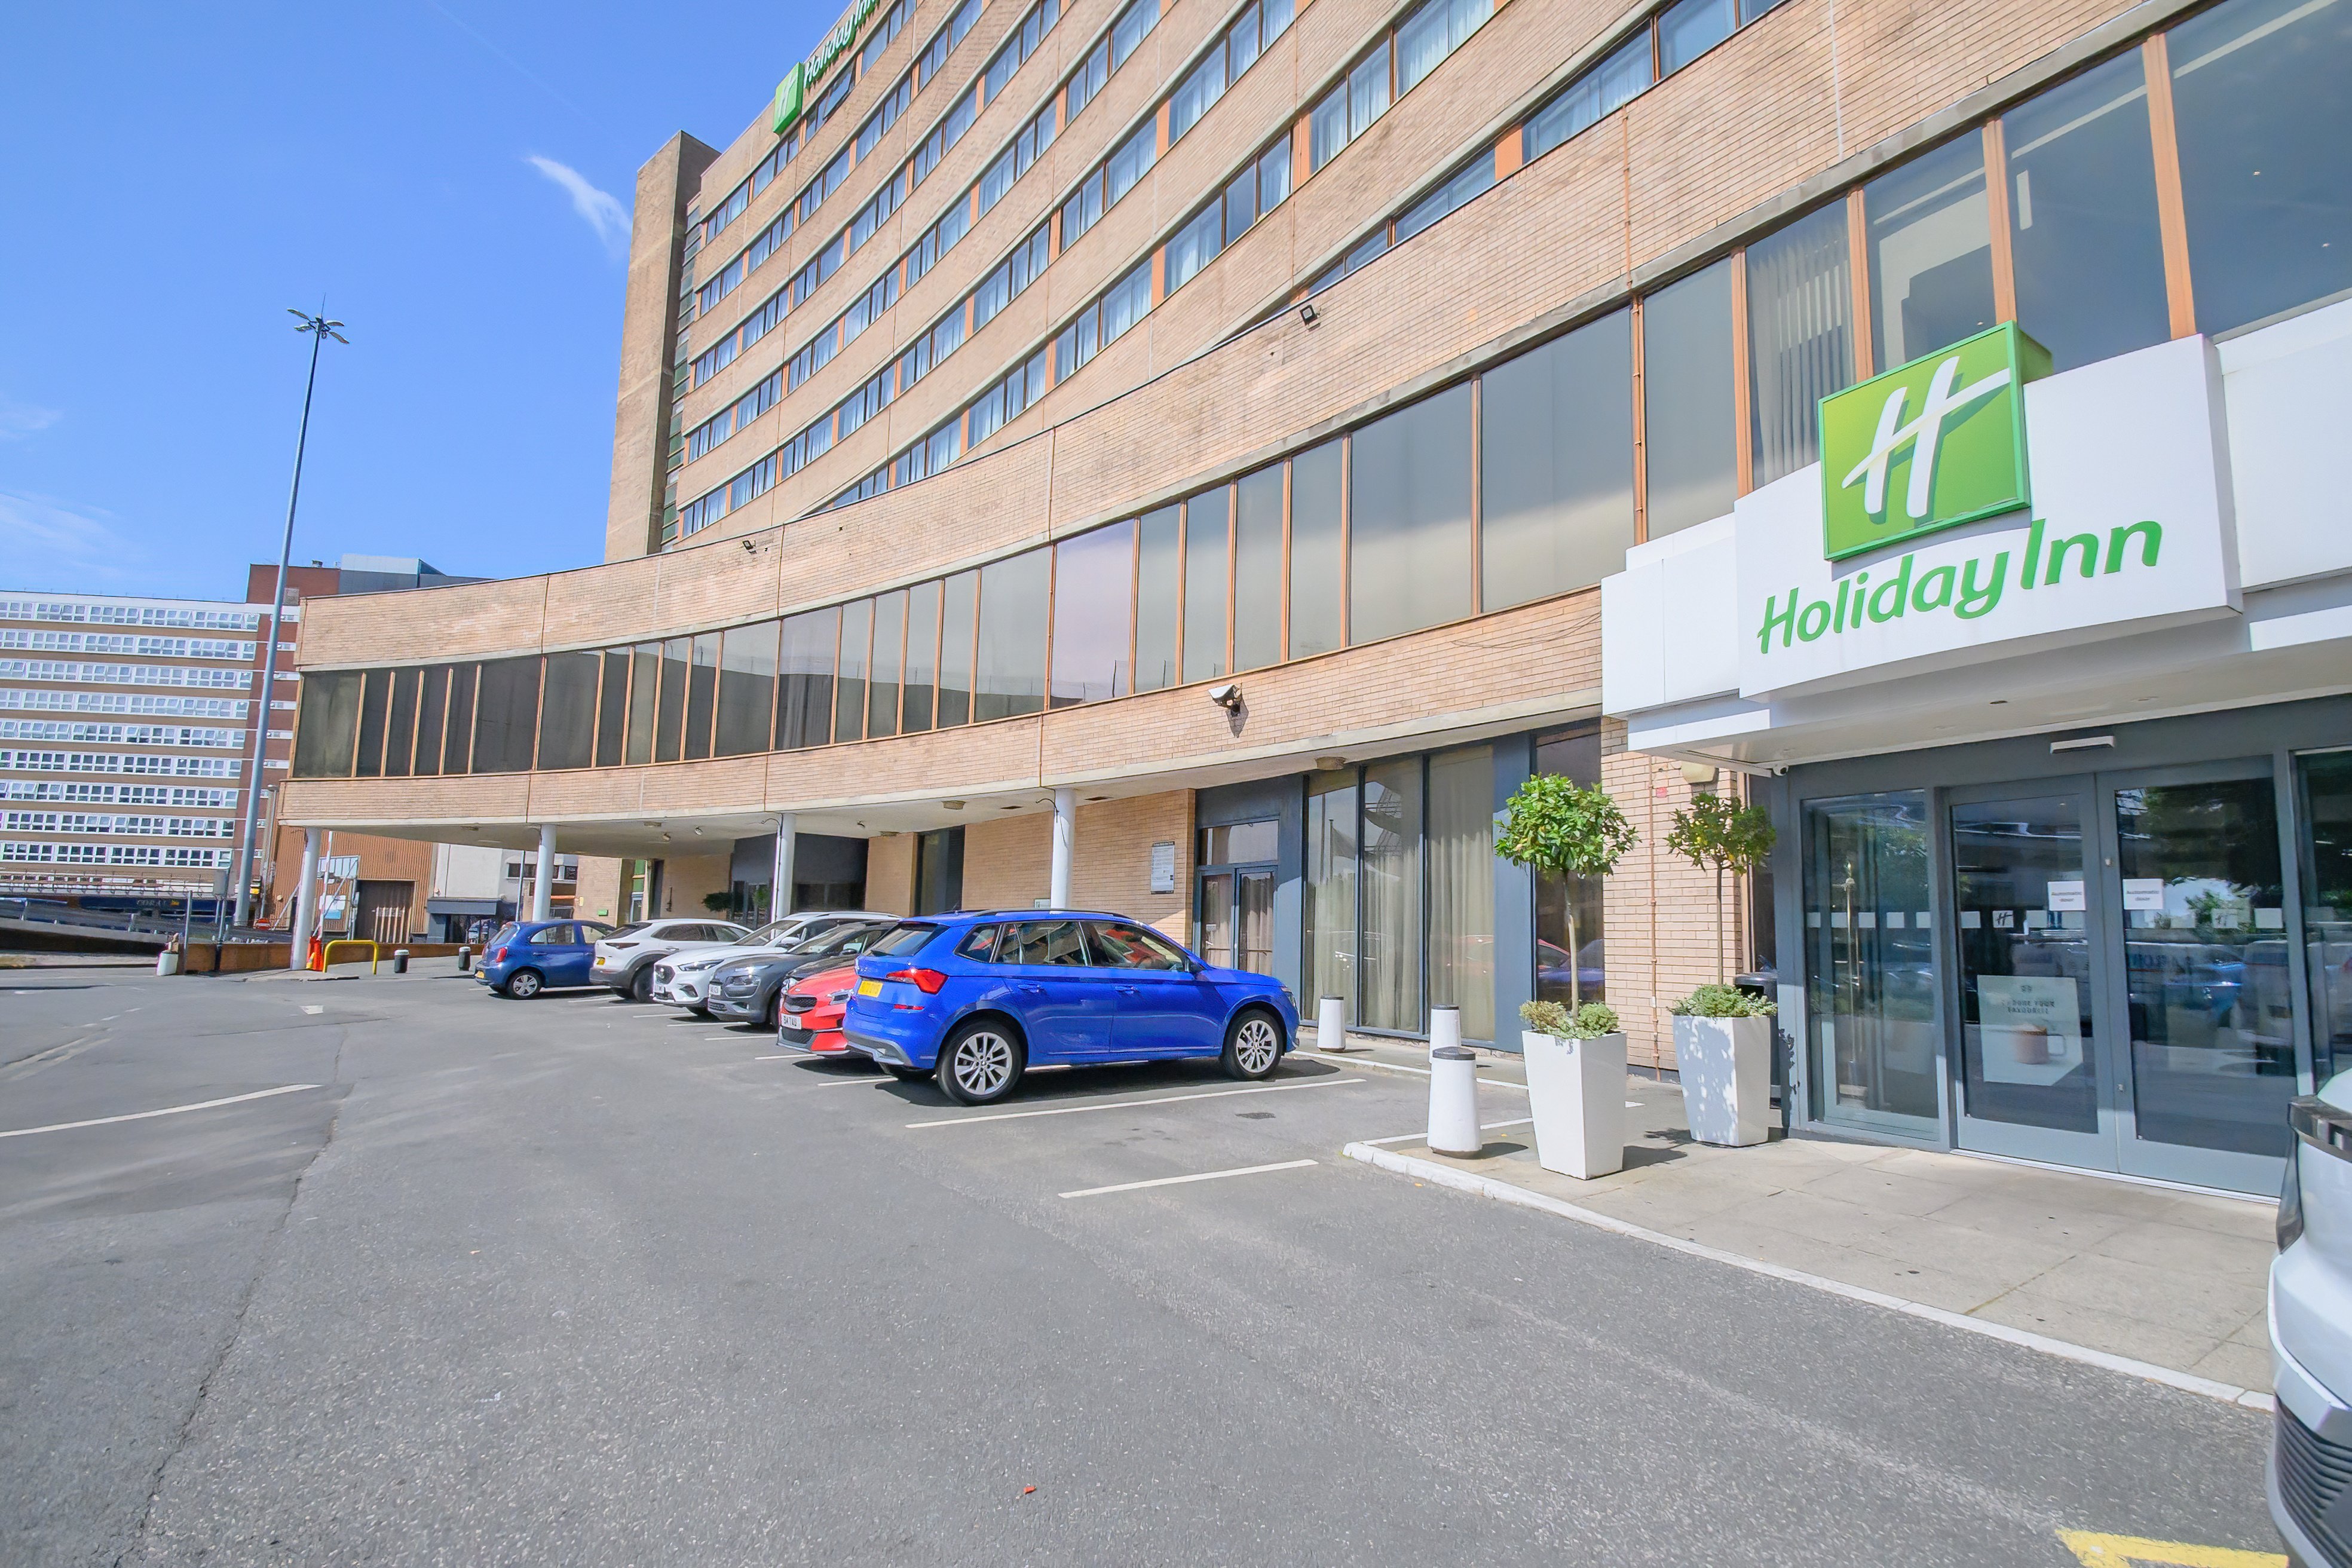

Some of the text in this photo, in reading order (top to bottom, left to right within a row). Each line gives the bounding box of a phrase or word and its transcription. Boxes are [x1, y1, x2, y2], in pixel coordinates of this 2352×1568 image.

[804, 0, 875, 88] Holiday In
[1841, 356, 2011, 518] H
[1757, 518, 2163, 654] Holiday Inn
